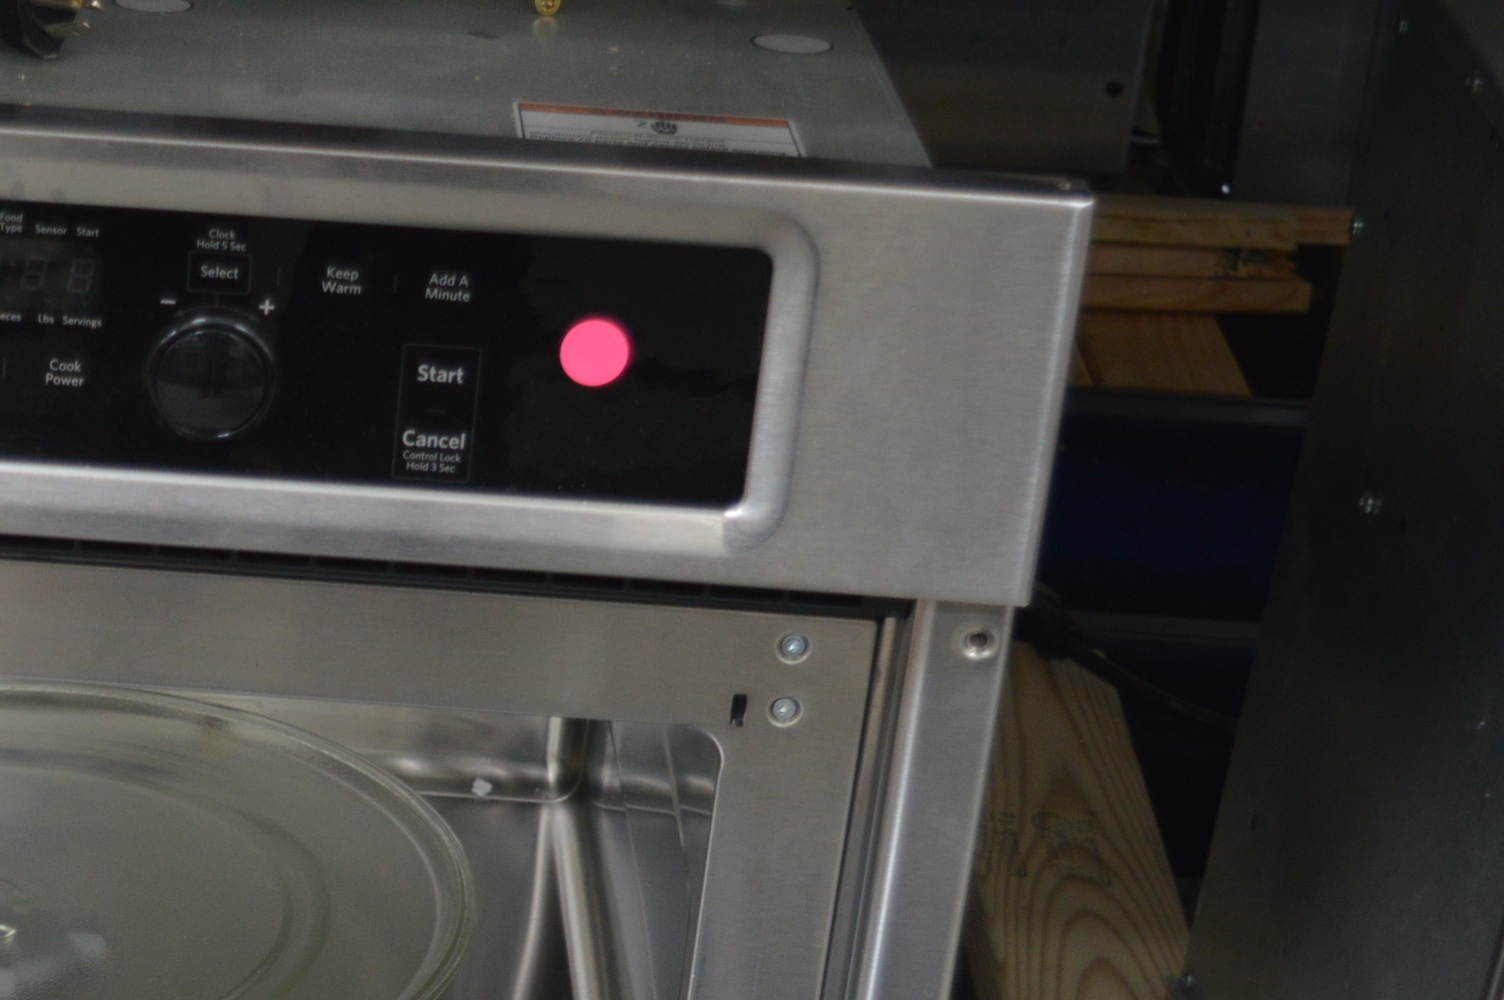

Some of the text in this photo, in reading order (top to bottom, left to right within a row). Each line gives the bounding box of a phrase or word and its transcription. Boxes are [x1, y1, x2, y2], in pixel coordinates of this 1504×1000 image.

[0, 212, 23, 223] Food
[0, 223, 23, 234] Type
[35, 224, 67, 236] Sensor
[76, 226, 99, 238] Start
[208, 228, 236, 240] Clock
[196, 239, 219, 249] Hold
[229, 241, 247, 252] Sec
[200, 265, 239, 280] Select
[326, 266, 359, 282] Keep
[428, 273, 469, 287] Add A
[321, 281, 362, 296] Warm
[425, 288, 471, 302] Minute
[38, 314, 55, 324] Lbs
[62, 315, 103, 329] Servings
[49, 358, 81, 373] Cook
[45, 372, 85, 387] Power
[416, 364, 464, 385] Start
[401, 429, 466, 451] Cancel
[402, 450, 462, 463] Control Lock
[406, 461, 456, 474] Hold 3 Sec
